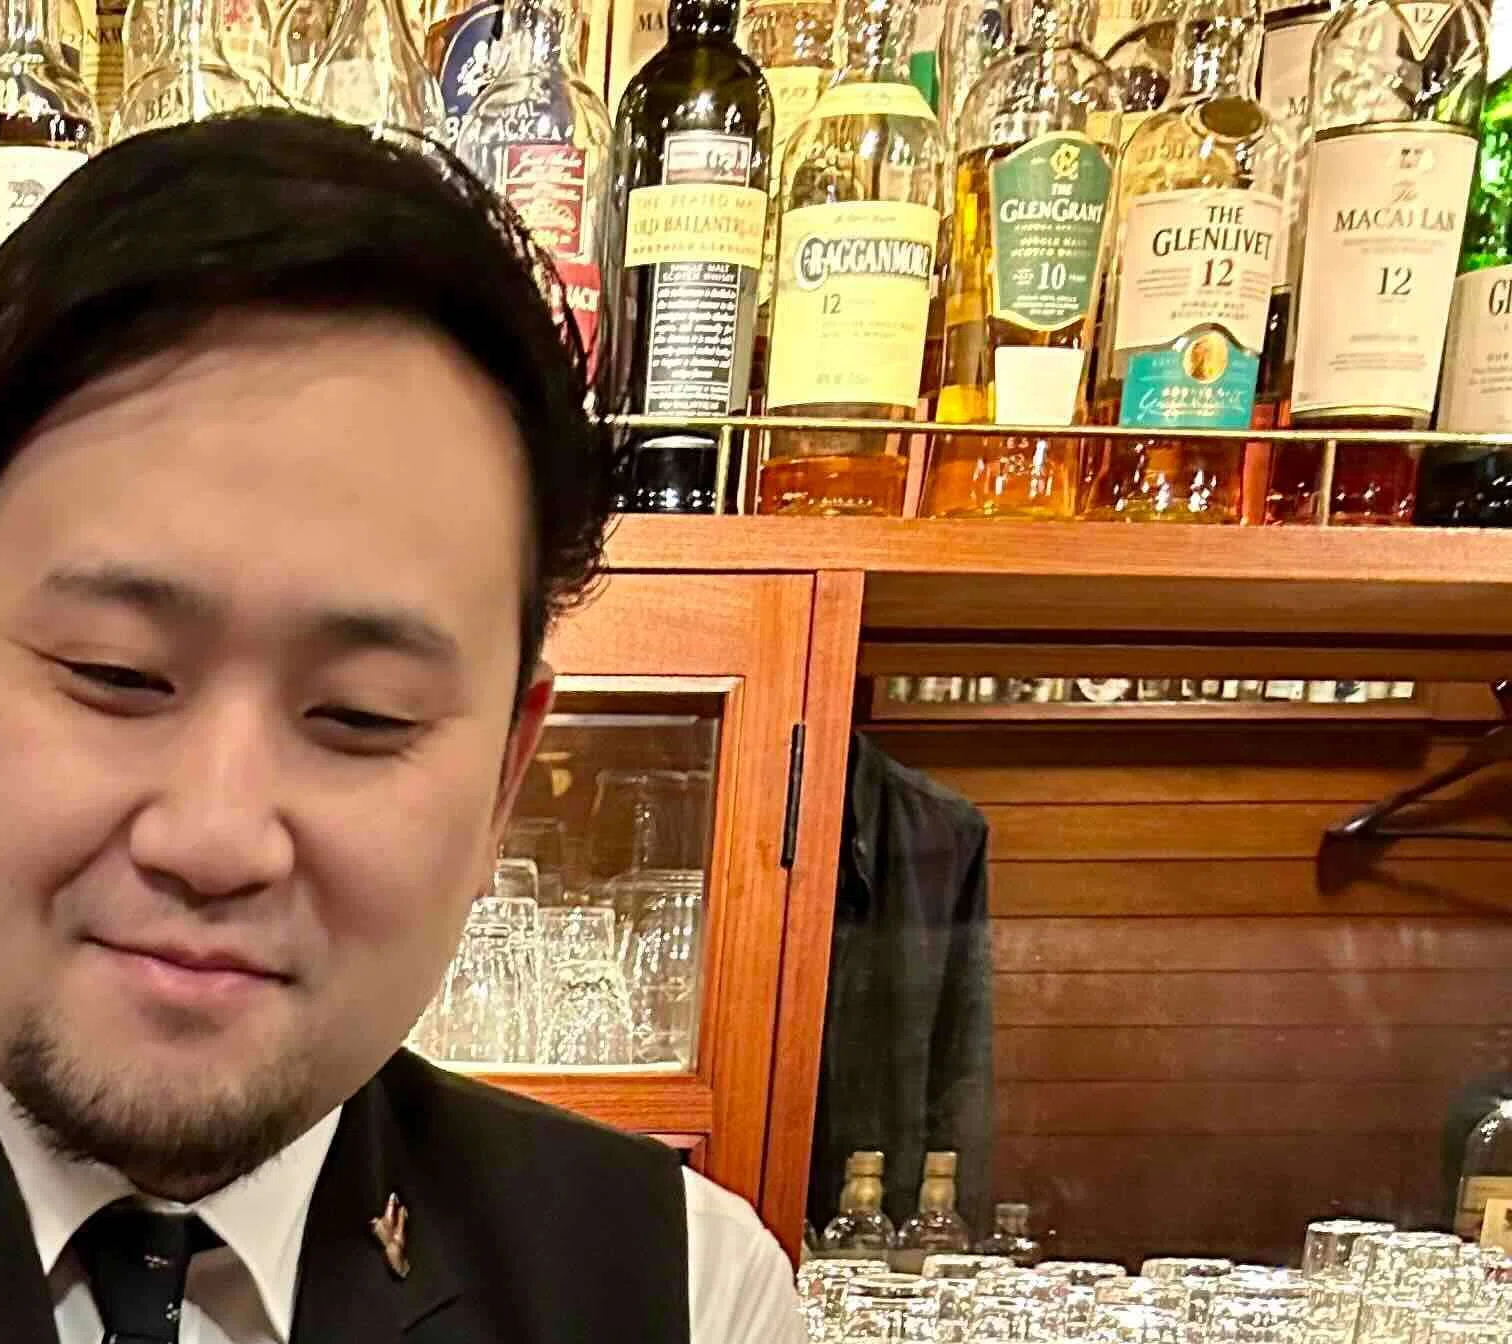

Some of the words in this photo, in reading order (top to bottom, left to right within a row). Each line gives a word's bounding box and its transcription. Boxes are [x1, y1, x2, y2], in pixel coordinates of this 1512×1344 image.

[1208, 206, 1245, 225] THE
[1152, 227, 1272, 261] GLENLIVET
[1038, 261, 1066, 290] 10
[1201, 258, 1234, 288] 12
[1376, 267, 1413, 296] 12
[822, 293, 842, 315] 12
